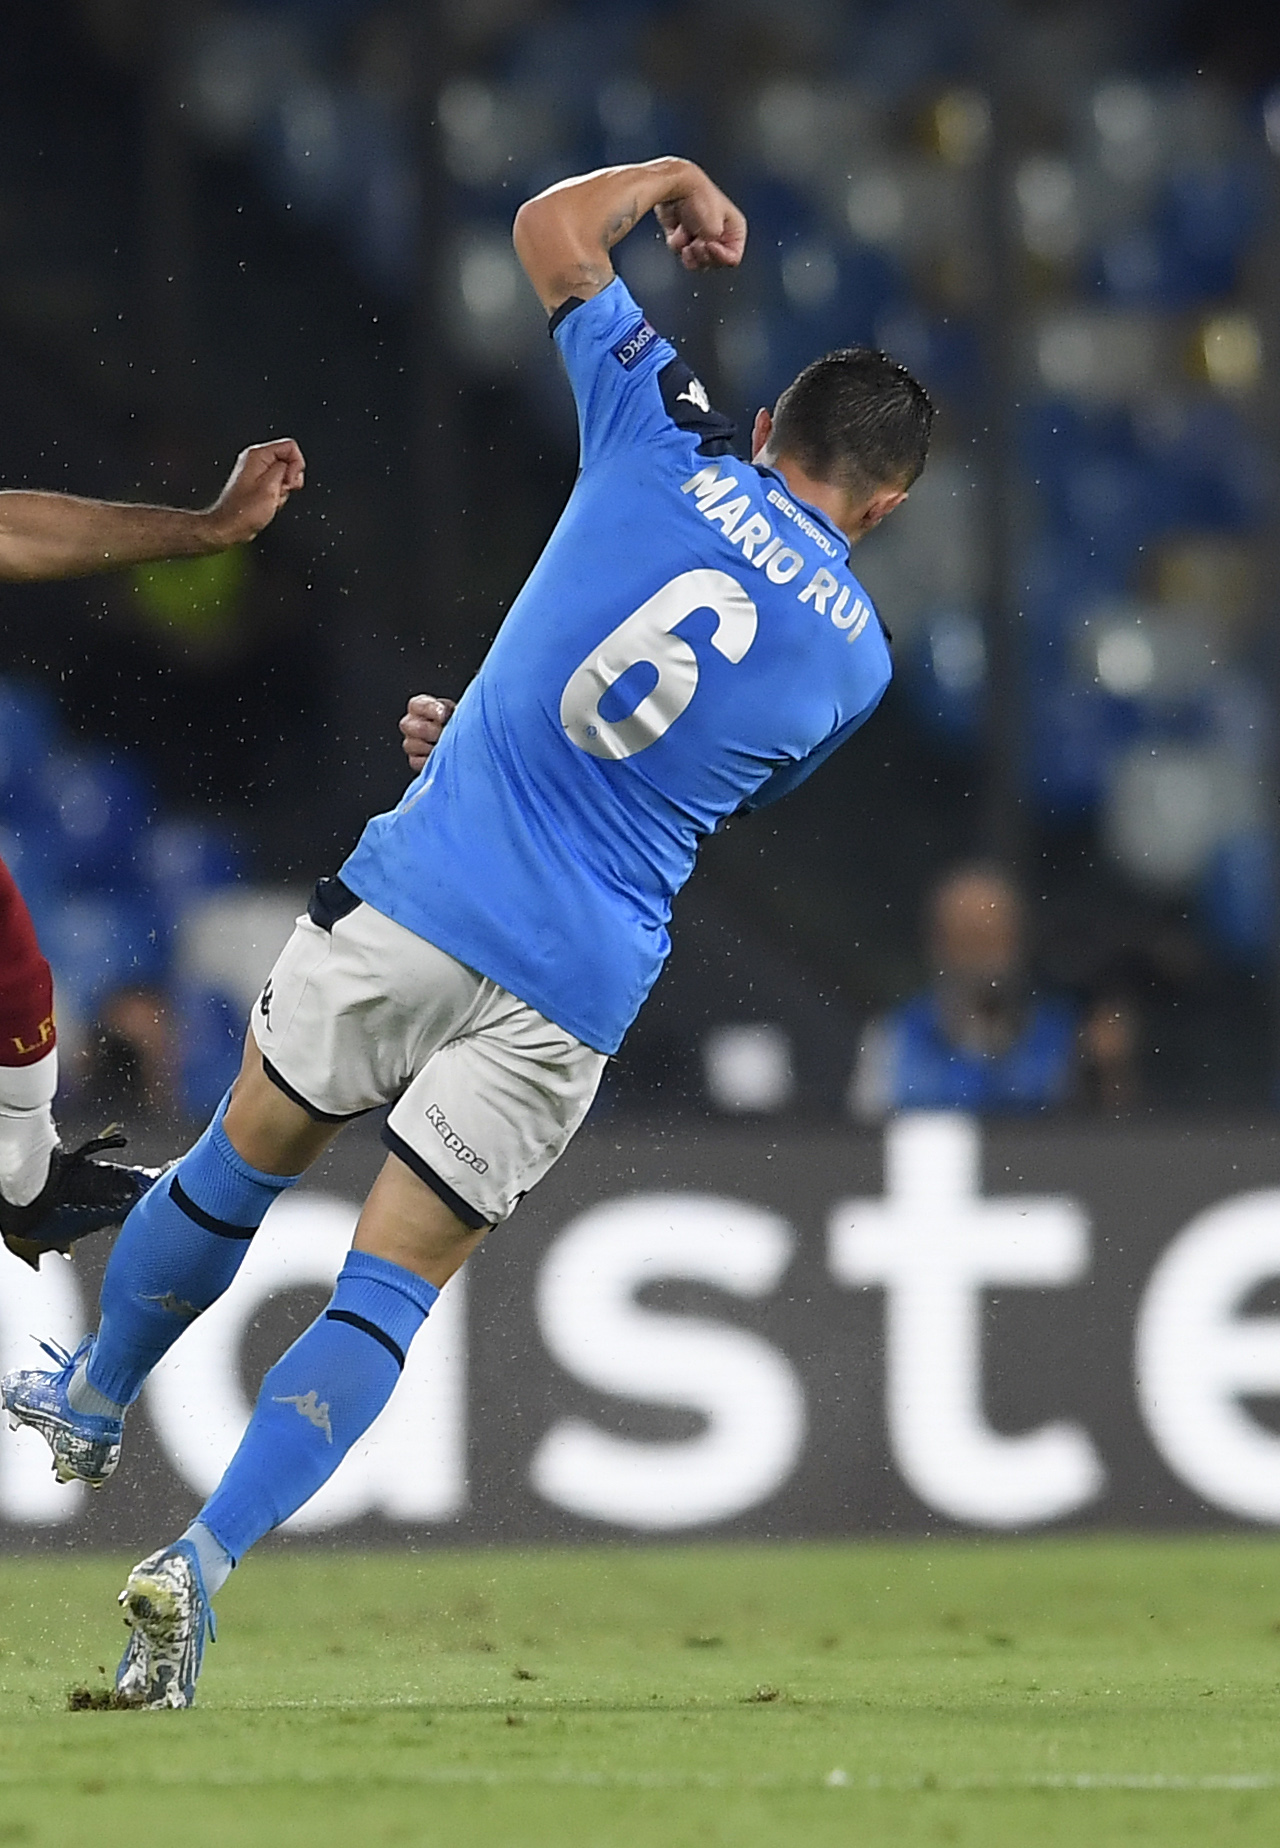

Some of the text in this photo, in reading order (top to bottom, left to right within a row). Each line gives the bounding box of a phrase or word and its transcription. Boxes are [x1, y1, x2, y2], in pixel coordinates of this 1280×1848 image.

[680, 465, 870, 643] MARIO RUI
[793, 512, 838, 558] NAPOLI
[560, 568, 758, 761] 6
[425, 1103, 489, 1175] Kappa
